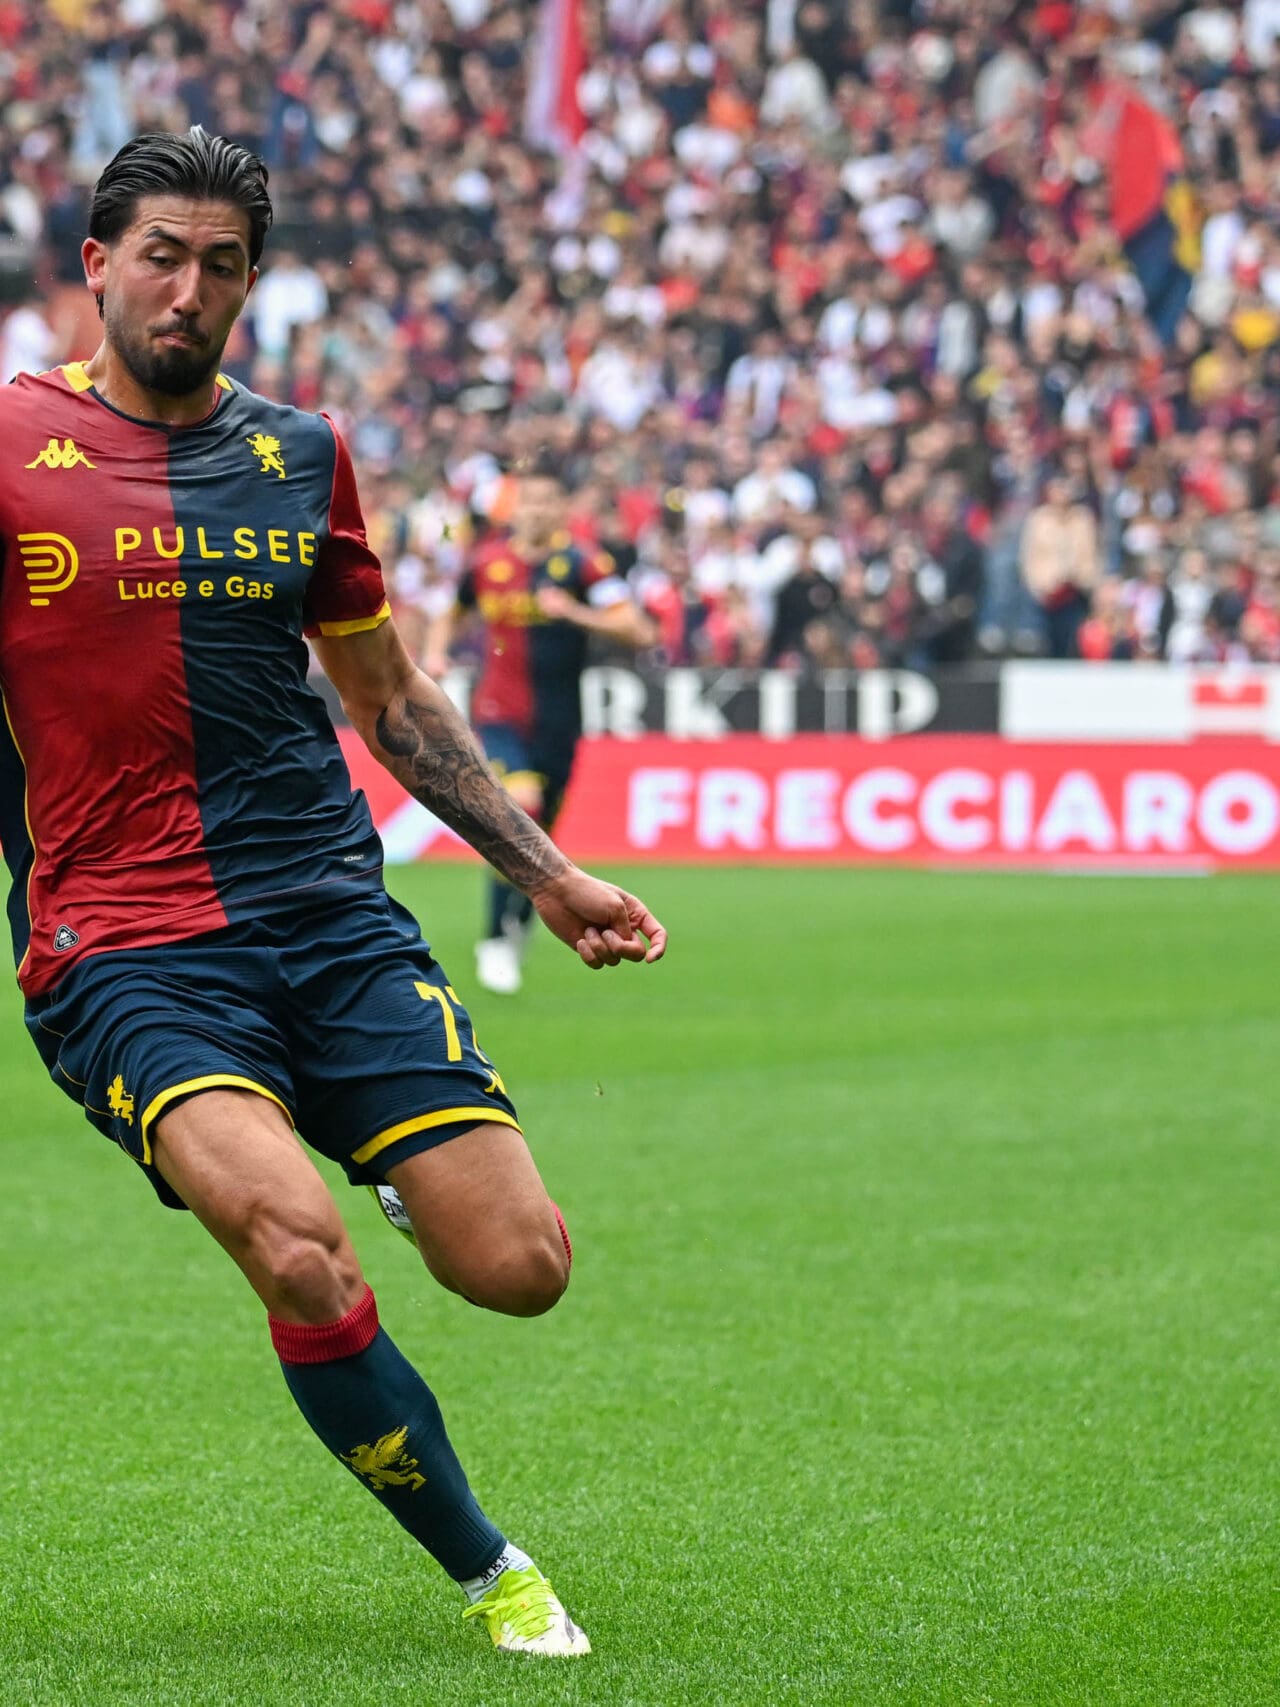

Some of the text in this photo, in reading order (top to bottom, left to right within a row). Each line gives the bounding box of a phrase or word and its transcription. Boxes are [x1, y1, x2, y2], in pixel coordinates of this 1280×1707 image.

[114, 526, 317, 567] PULSEE
[118, 575, 275, 600] Luce e Gas
[625, 766, 1280, 854] FRECCIARO
